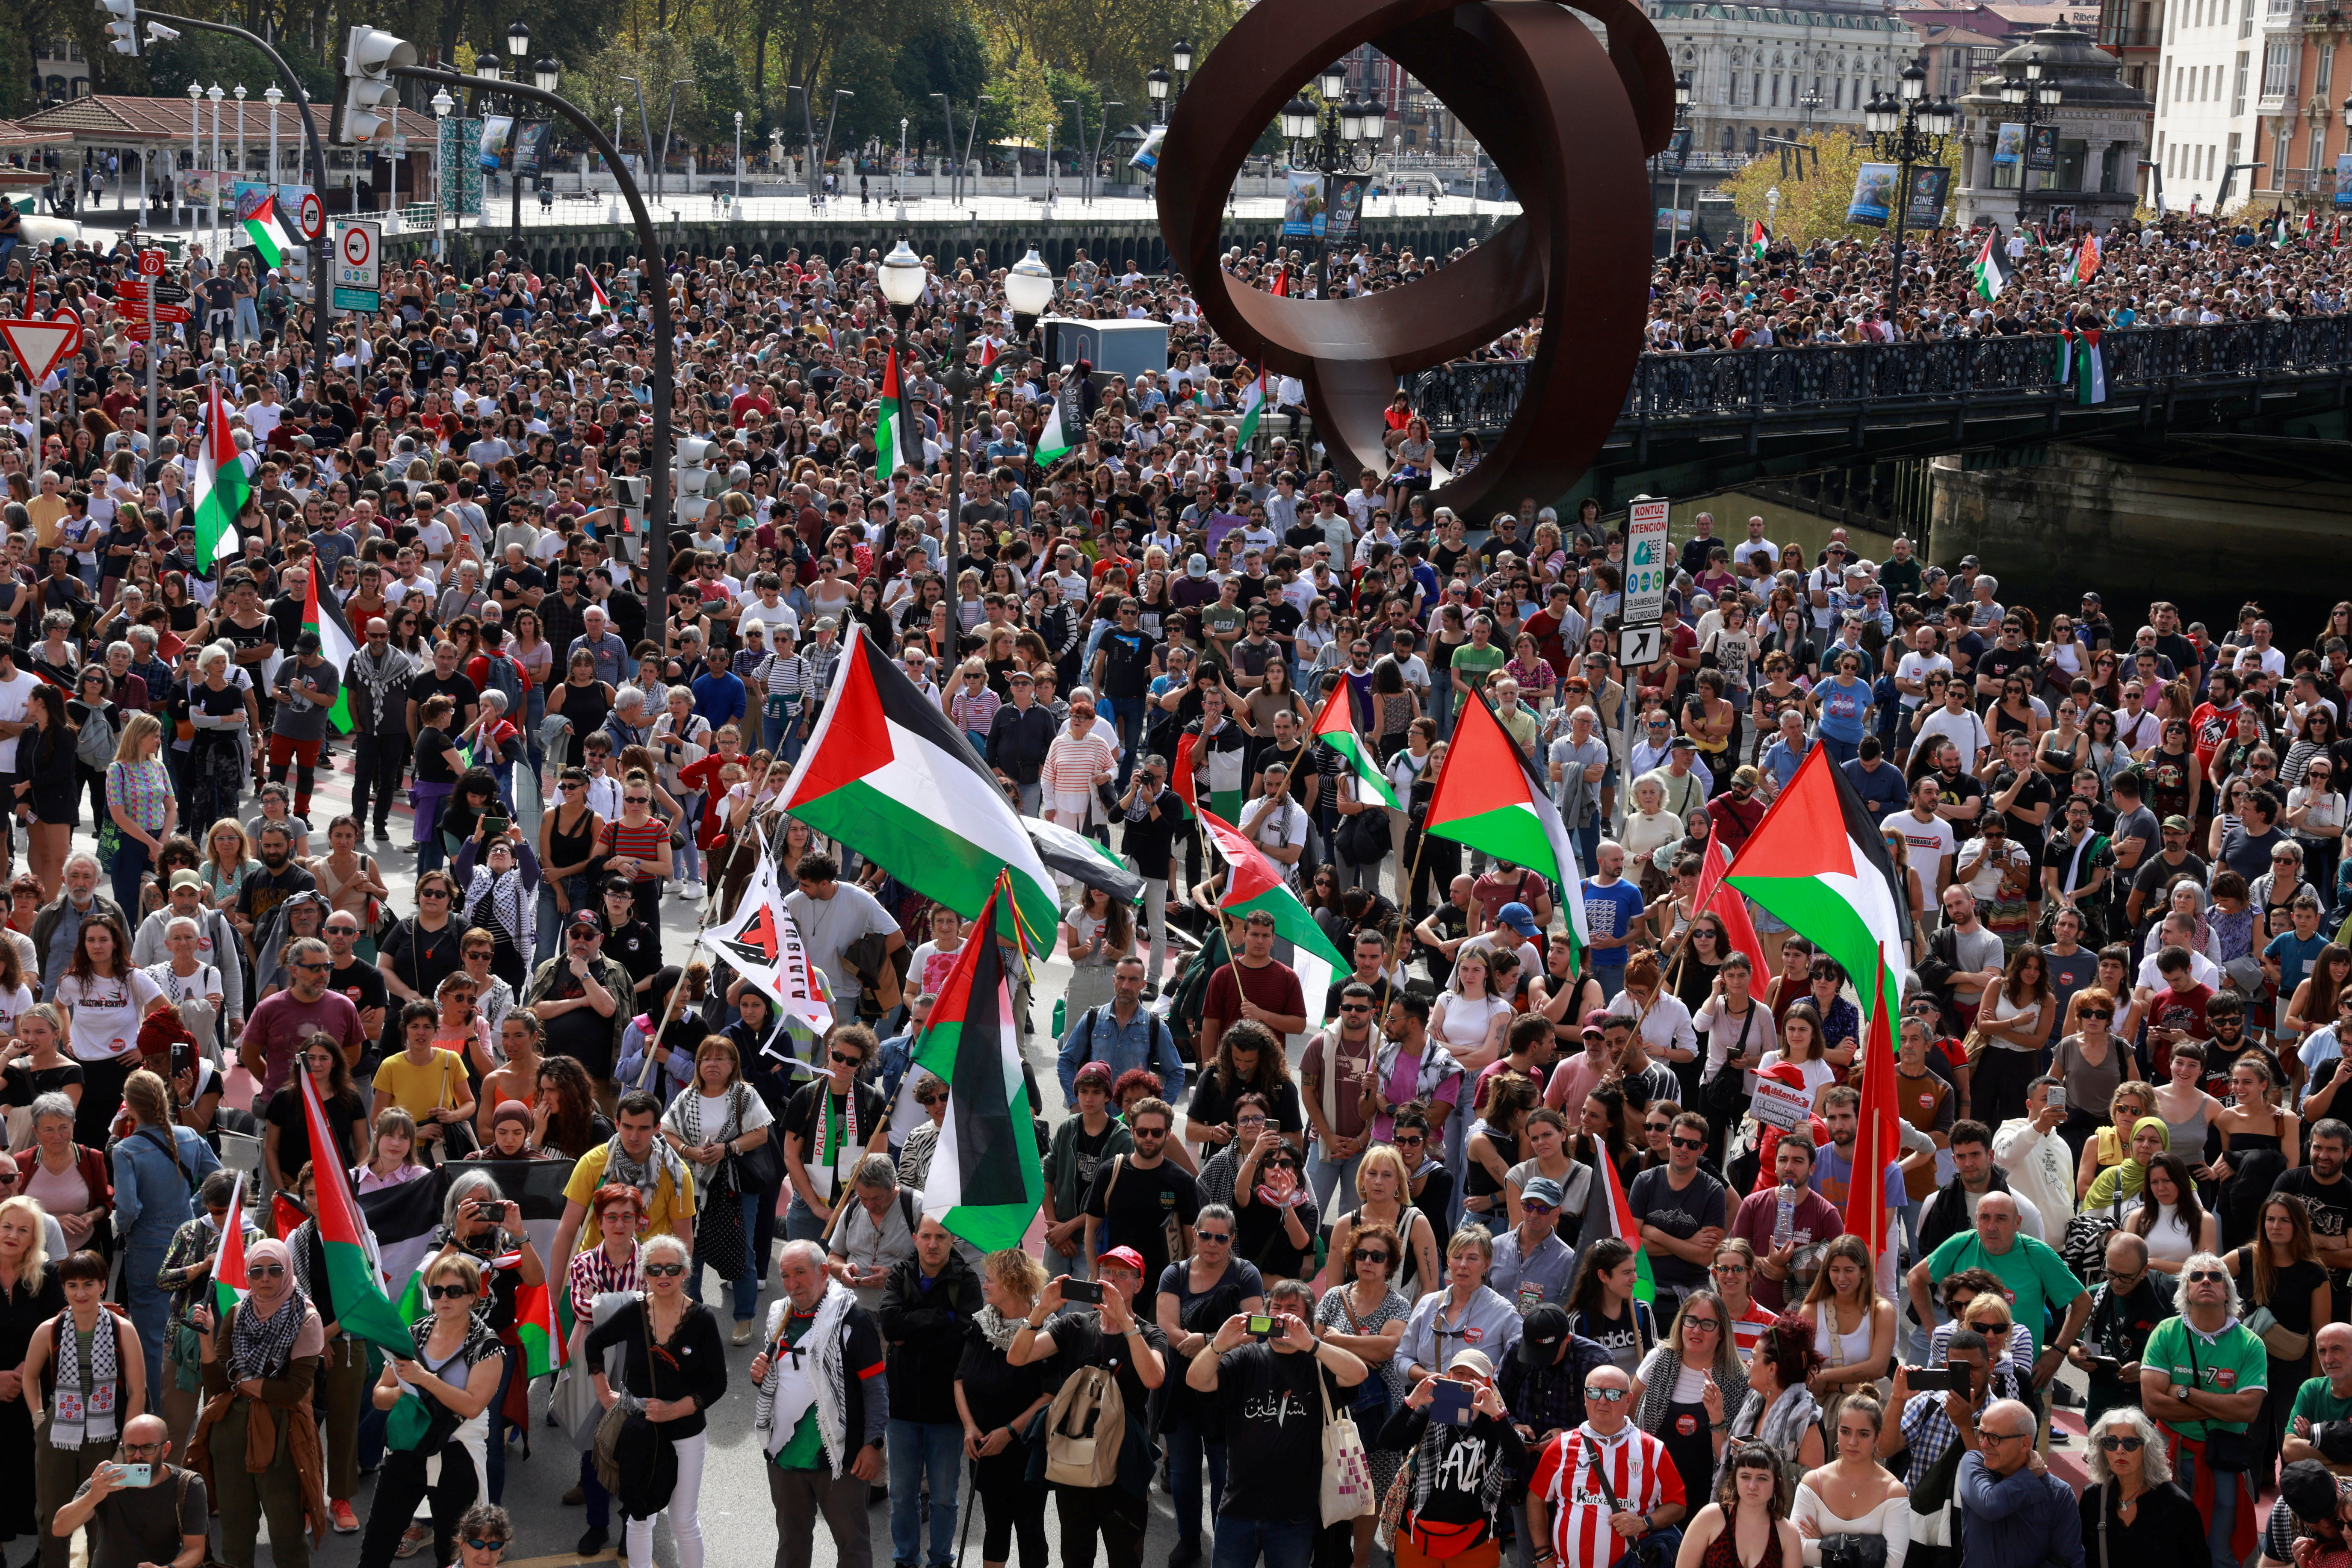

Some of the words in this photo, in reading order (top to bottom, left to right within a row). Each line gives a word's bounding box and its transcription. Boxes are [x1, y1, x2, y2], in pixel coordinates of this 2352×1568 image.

[2073, 12, 2101, 22] Ribera
[518, 146, 536, 154] CINE
[1663, 151, 1679, 159] CINE
[1914, 196, 1934, 205] CINE
[1065, 389, 1083, 431] DENOK
[1634, 504, 1664, 517] KONTUZ
[1630, 520, 1666, 534] ATENCIÓN
[1647, 539, 1661, 551] EGE
[1646, 552, 1660, 564] ZBE
[1656, 574, 1661, 587] C
[1625, 599, 1633, 608] ETA
[1634, 596, 1662, 607] BAIMENDUAK
[1629, 609, 1659, 620] AUTORIZADOS
[78, 999, 103, 1007] PALESTINA
[2207, 1071, 2228, 1081] ORIGINAL
[1757, 1084, 1801, 1103] Militante
[1756, 1098, 1764, 1108] EL
[1764, 1101, 1803, 1120] GENOCIDIO
[1759, 1108, 1795, 1128] SIONISTA
[1793, 1231, 1812, 1239] #SOMOS
[1523, 1282, 1540, 1293] SOS
[2207, 1365, 2219, 1386] 7
[1576, 1486, 1635, 1509] Kutxaank
